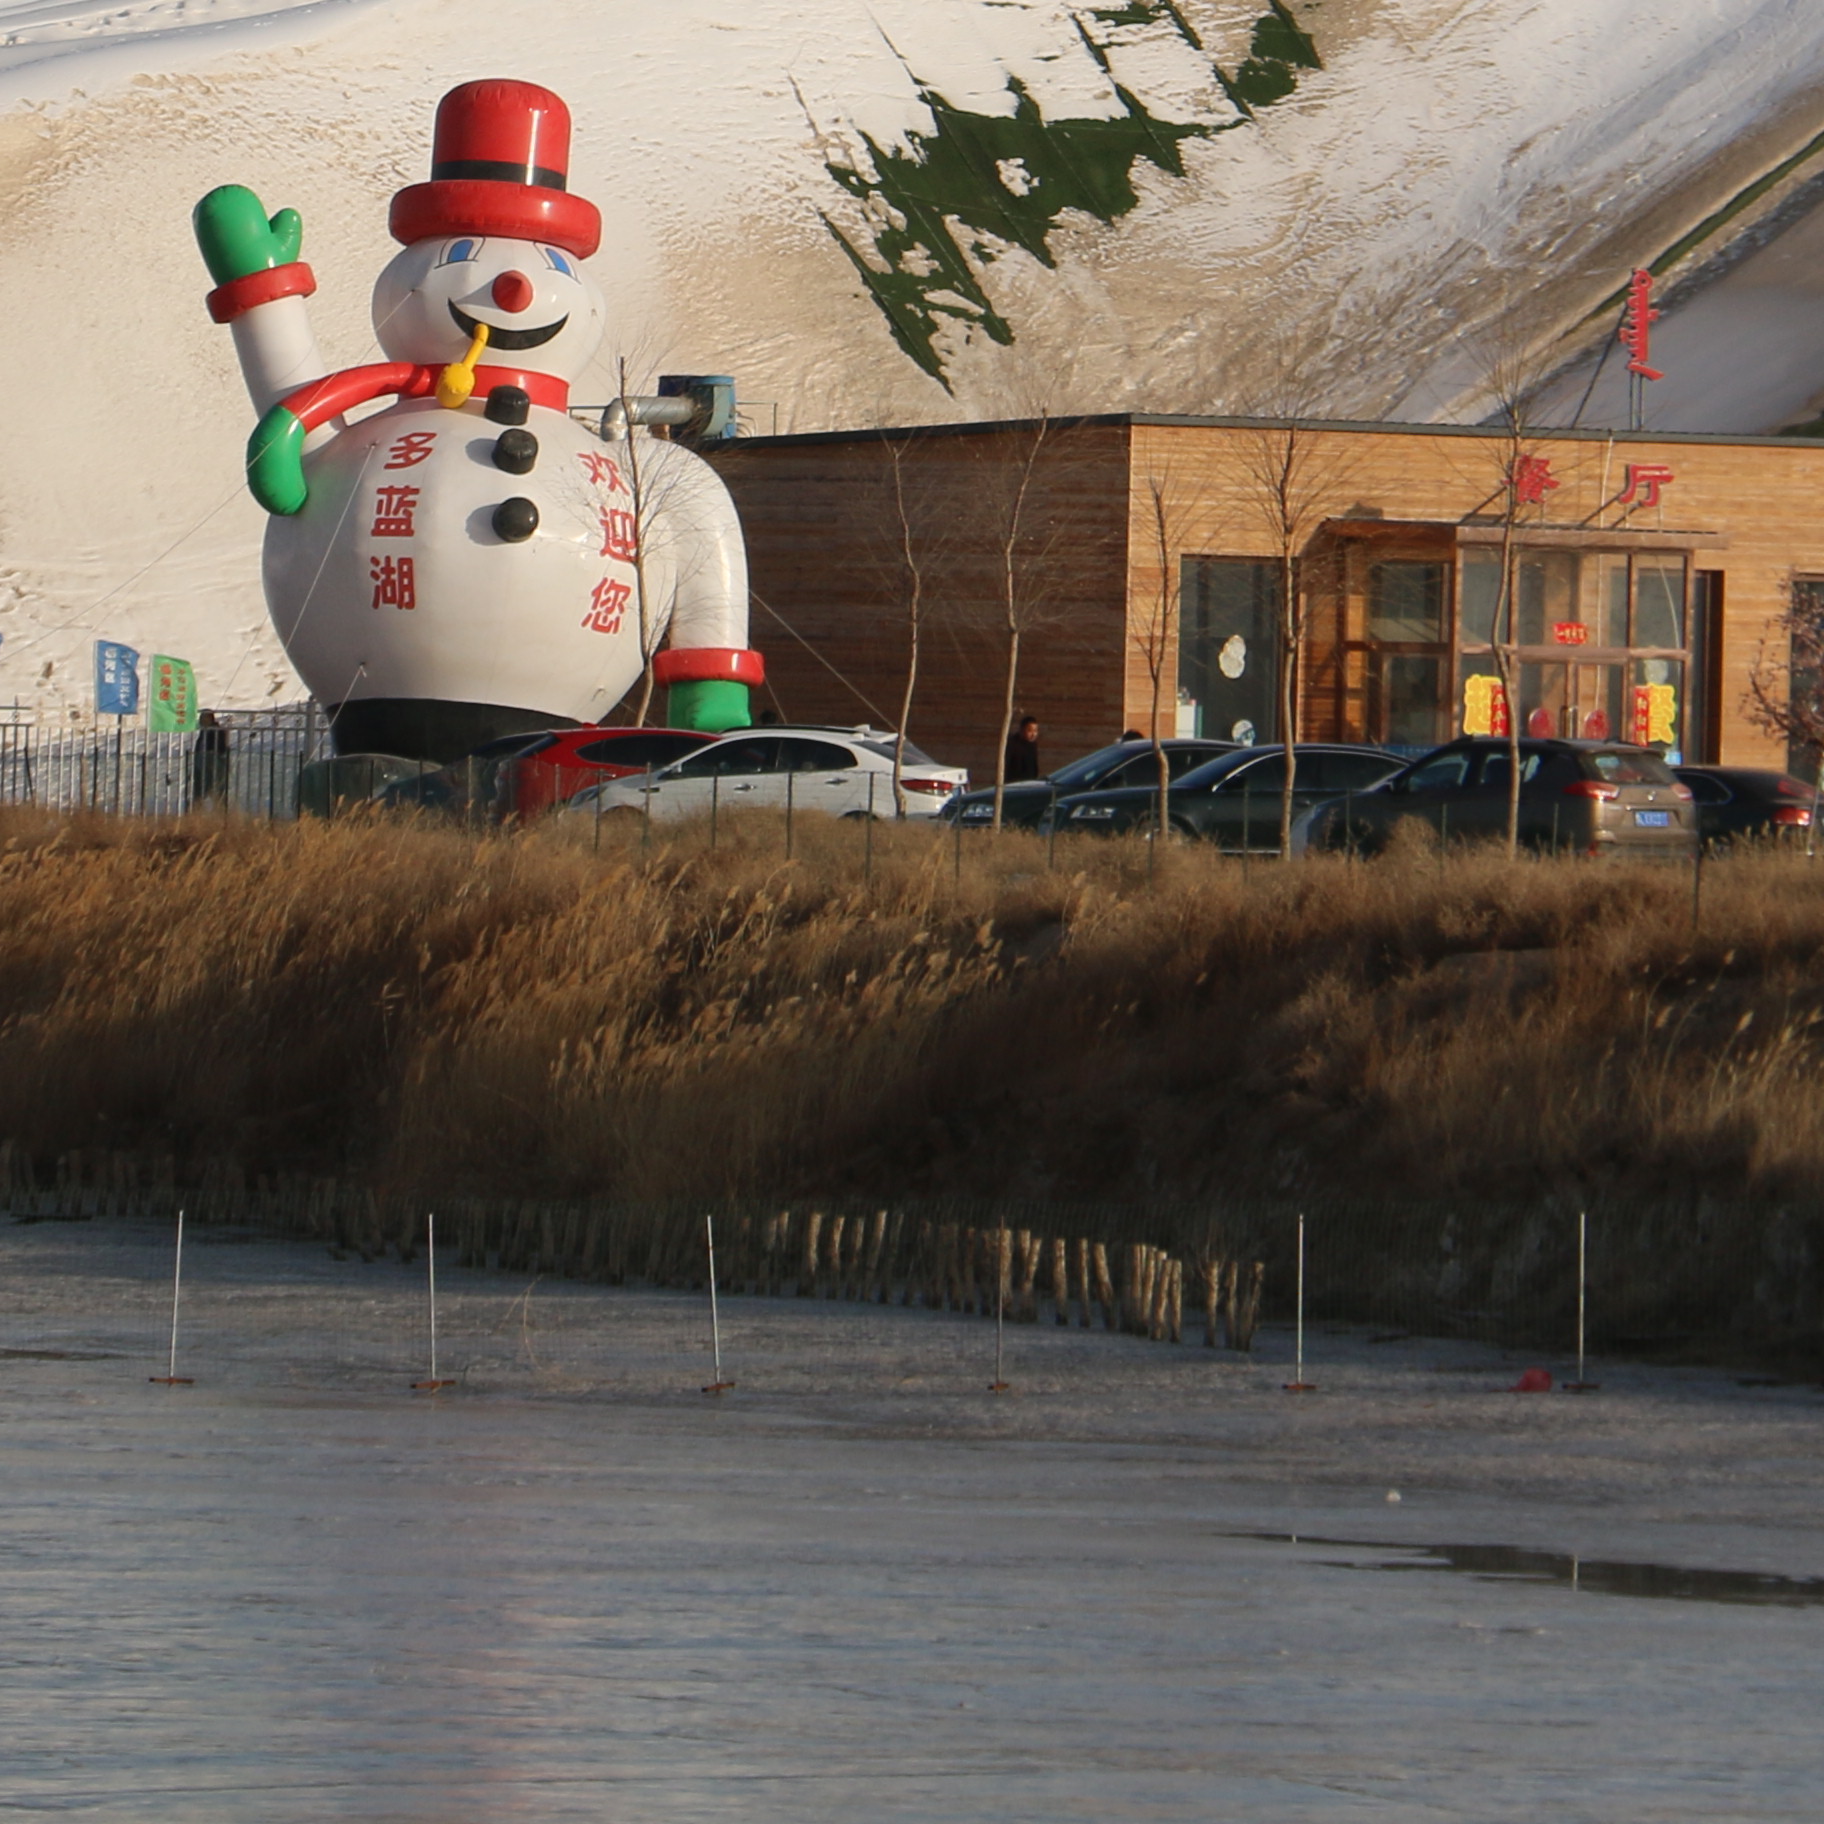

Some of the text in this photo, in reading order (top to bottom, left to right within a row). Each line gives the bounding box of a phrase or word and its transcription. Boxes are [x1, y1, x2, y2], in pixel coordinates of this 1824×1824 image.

[369, 431, 439, 611] 多蓝湖
[577, 450, 638, 636] 欢迎您
[1503, 454, 1675, 508] 餐厅
